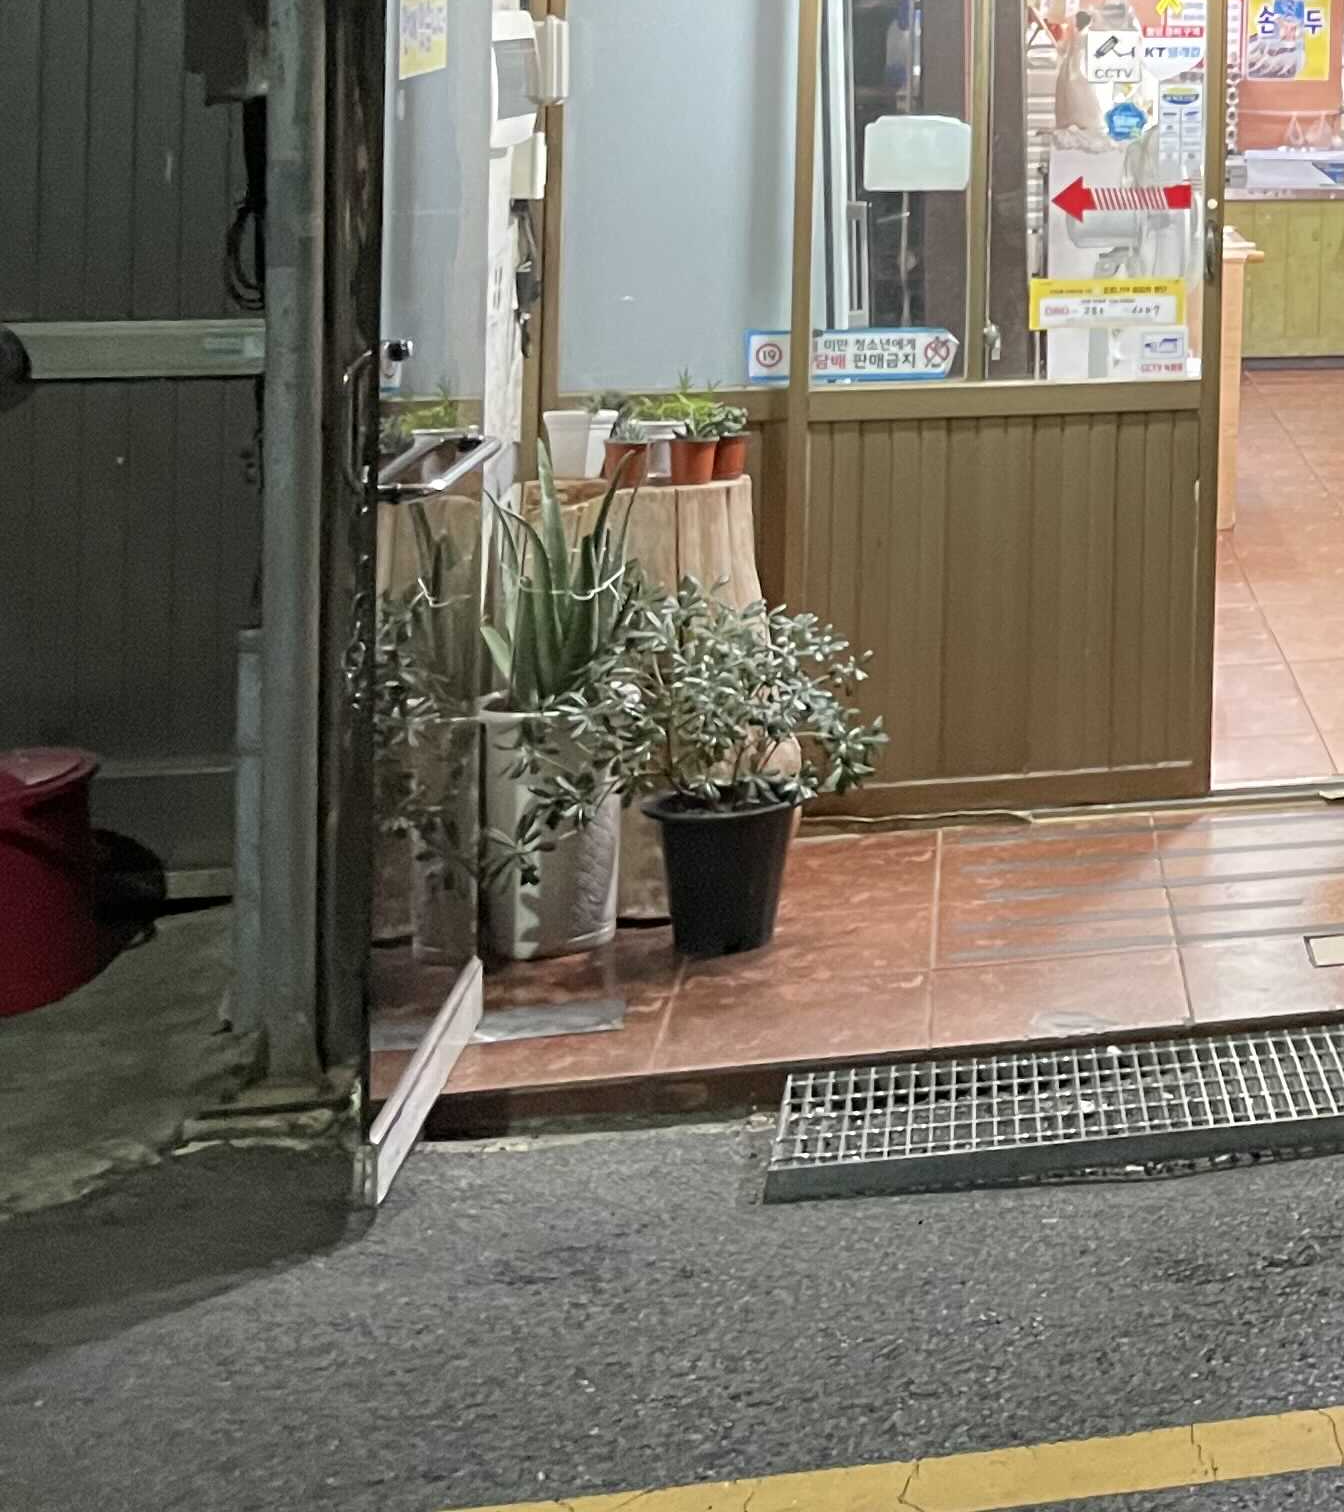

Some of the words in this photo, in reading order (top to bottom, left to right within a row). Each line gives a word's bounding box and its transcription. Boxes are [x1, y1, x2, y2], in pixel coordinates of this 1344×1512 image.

[1257, 6, 1323, 36] 손두
[1094, 67, 1133, 81] CCTV
[854, 337, 916, 351] 청소년에게
[814, 354, 846, 369] 담배
[853, 353, 916, 369] 판매금지
